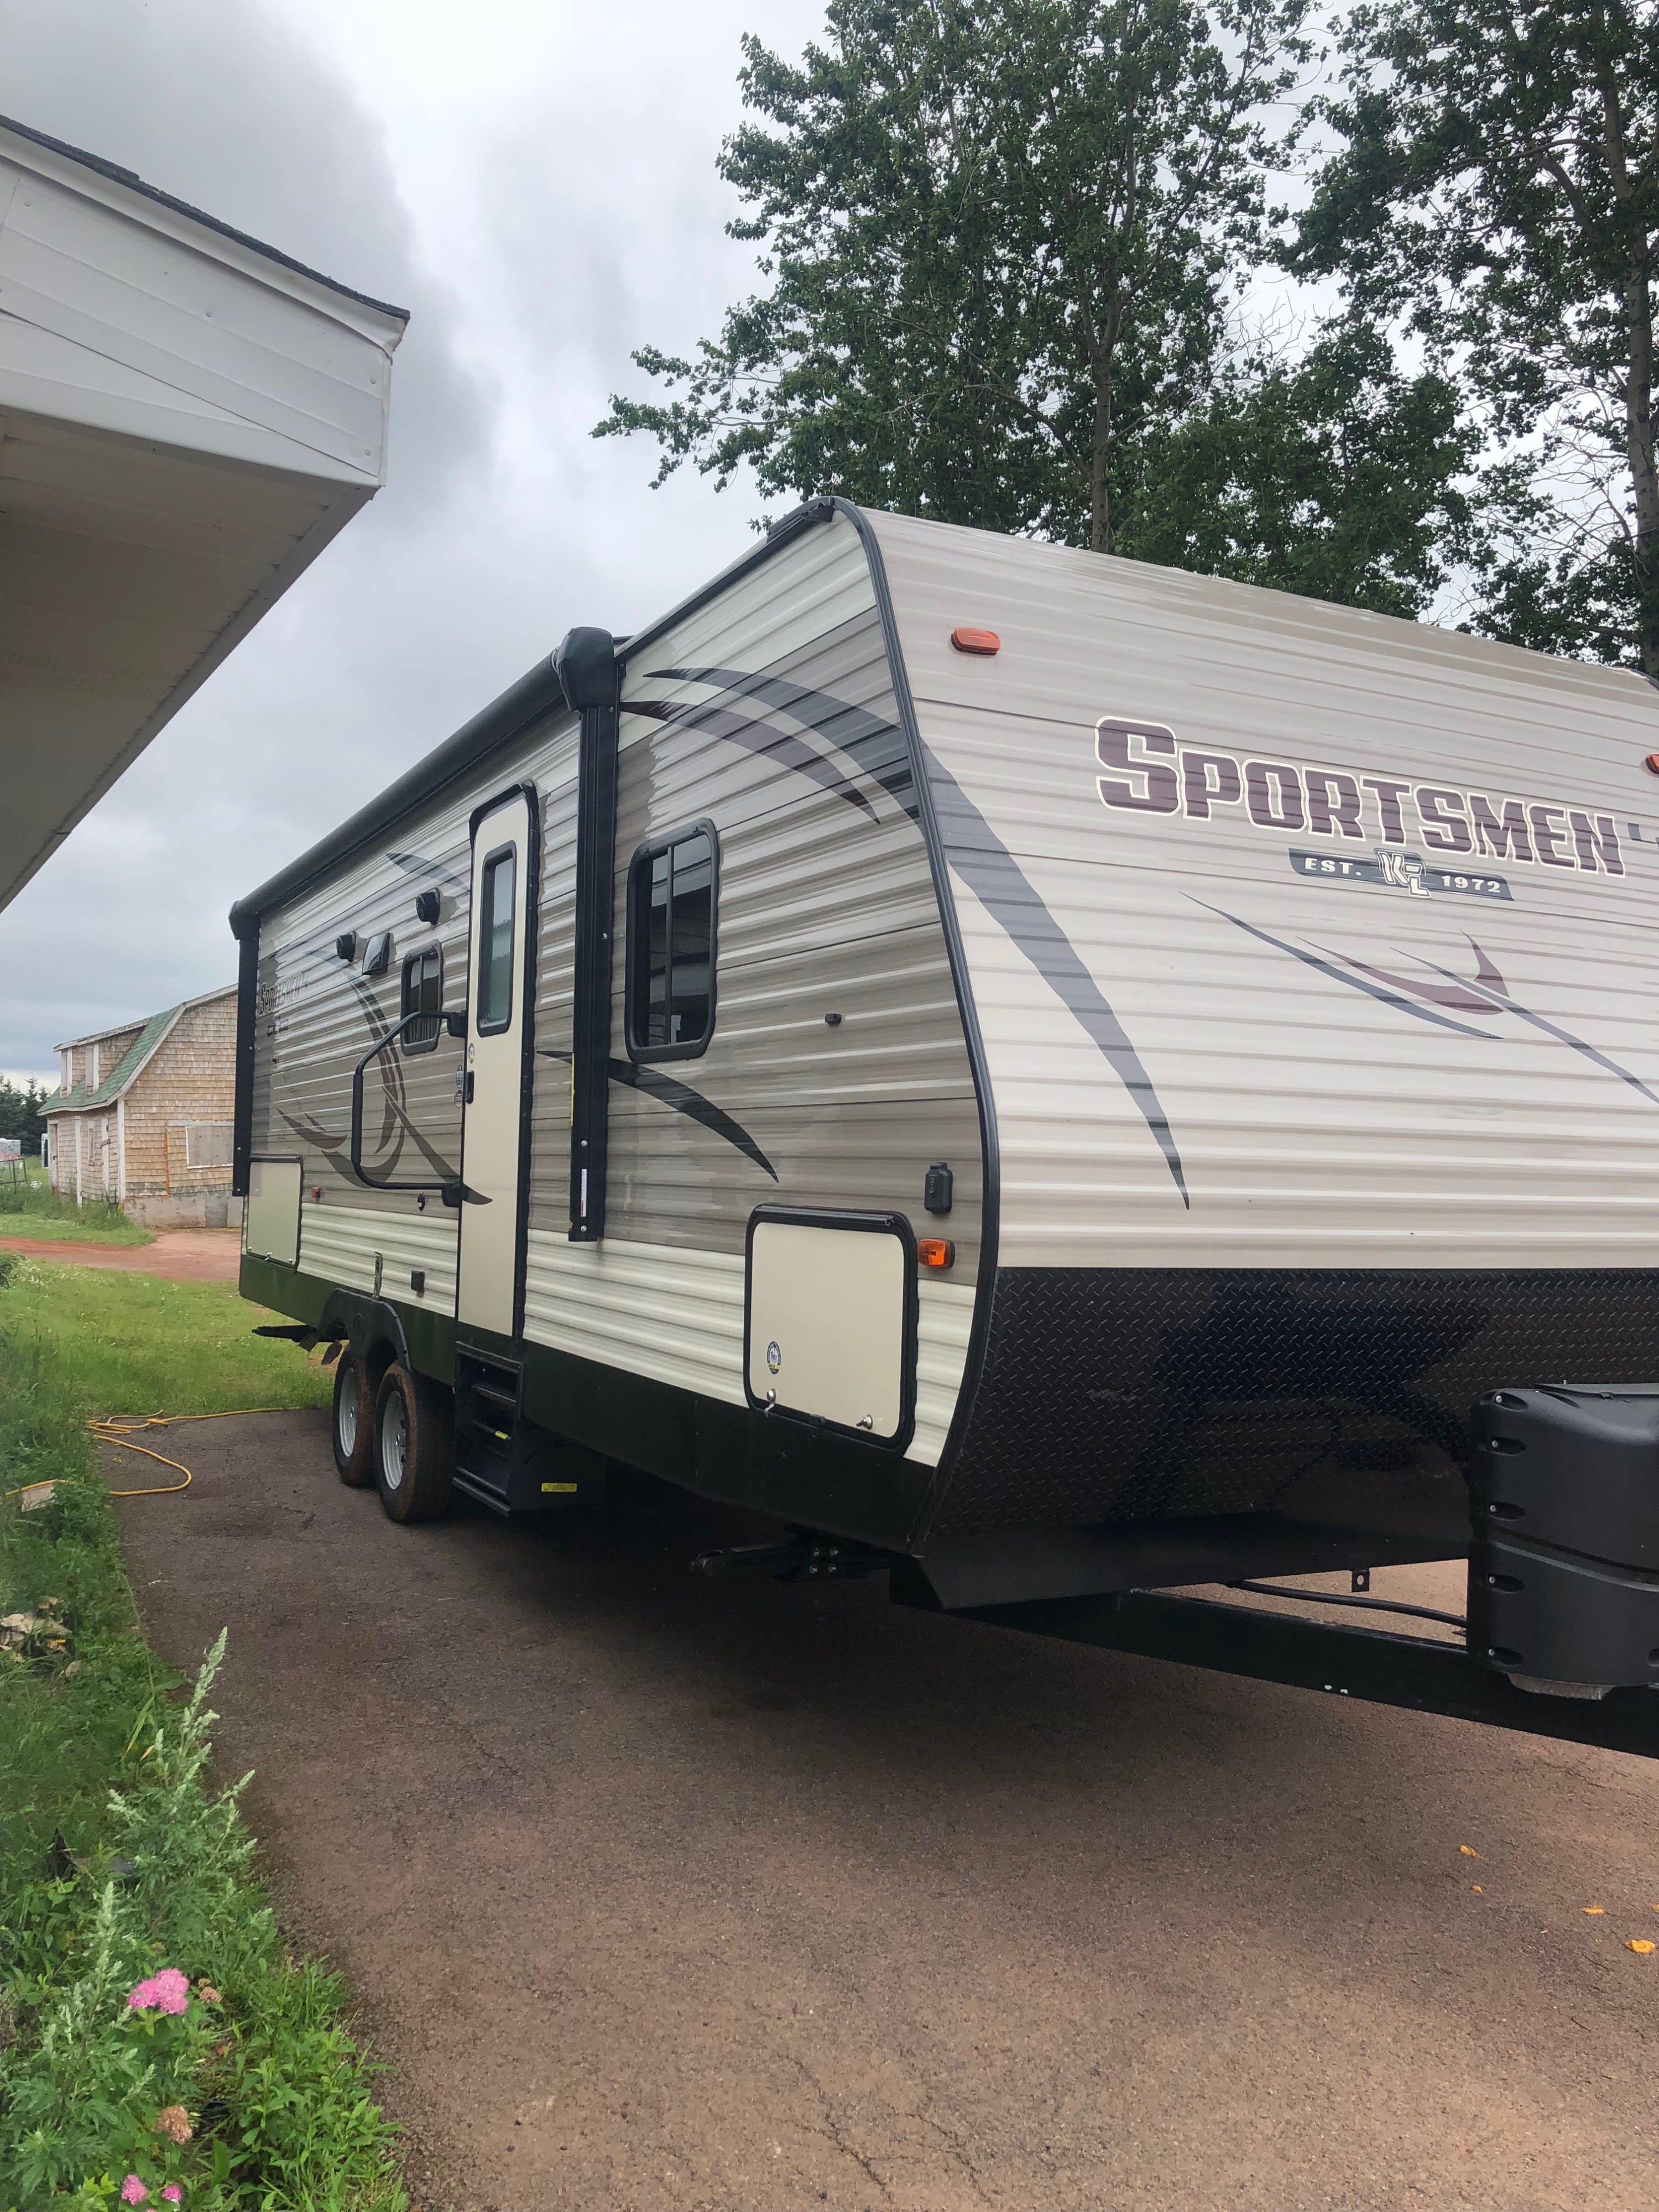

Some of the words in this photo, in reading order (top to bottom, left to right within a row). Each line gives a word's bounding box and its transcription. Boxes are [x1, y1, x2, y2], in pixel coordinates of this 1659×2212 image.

[1094, 716, 1625, 878] SPORTSMEN
[1304, 857, 1362, 876] EST.
[1441, 874, 1501, 893] 1972
